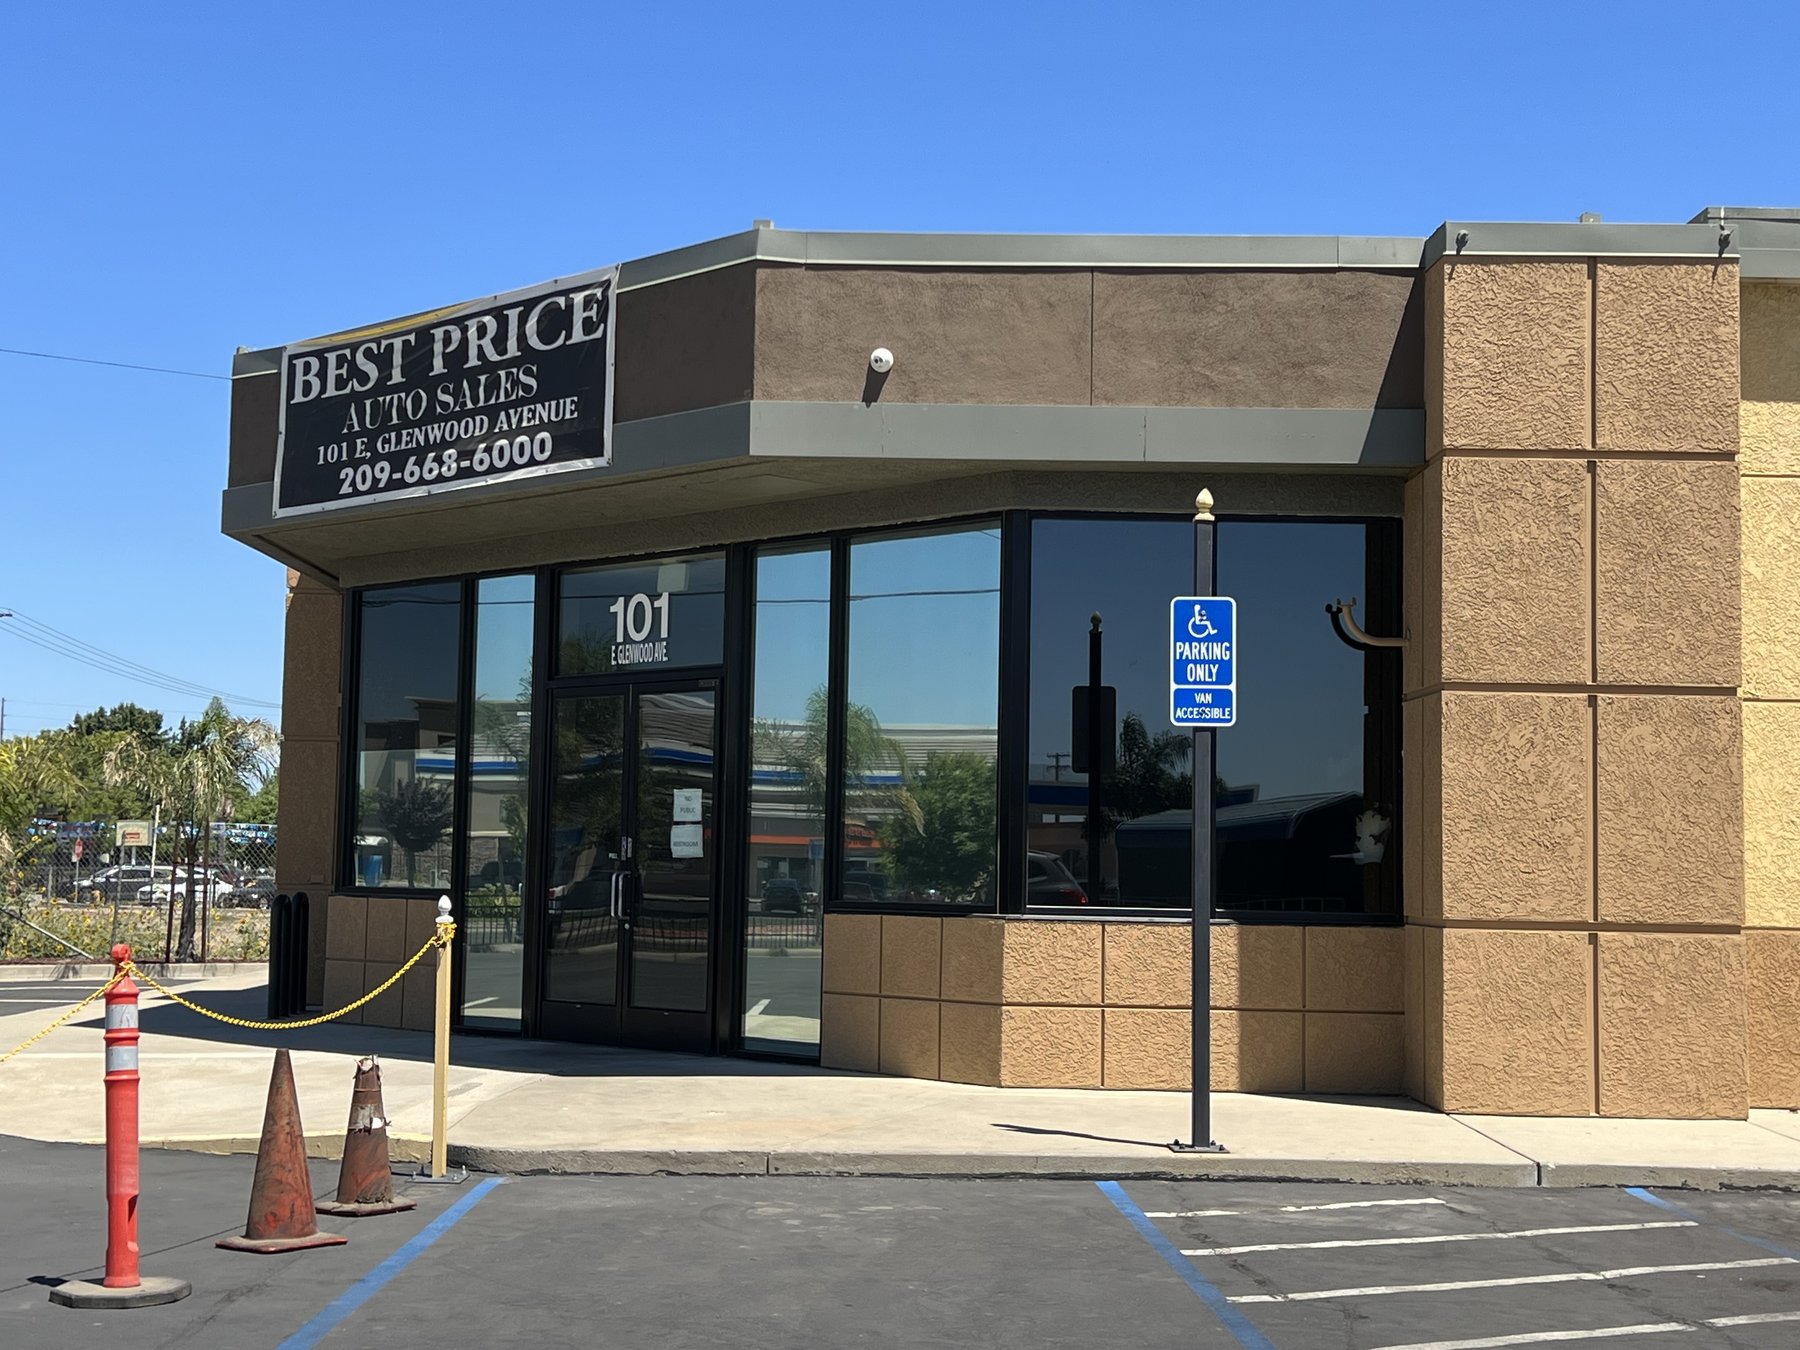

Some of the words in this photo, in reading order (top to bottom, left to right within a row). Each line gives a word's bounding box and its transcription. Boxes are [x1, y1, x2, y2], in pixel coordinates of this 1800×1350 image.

[290, 332, 416, 404] BEST
[428, 288, 606, 377] PRICE
[341, 388, 428, 434] AUTO
[435, 363, 538, 416] SALES
[317, 441, 350, 465] 101
[376, 414, 489, 454] GLENWOOD
[493, 396, 579, 434] AVENUE
[338, 431, 553, 495] 209-668-6000
[609, 591, 669, 643] 101
[617, 642, 654, 664] GLENWOOD
[1175, 641, 1231, 661] PARKING
[1186, 663, 1219, 682] ONLY
[1175, 707, 1231, 719] ACCESSIBLE
[1194, 692, 1212, 704] VAN
